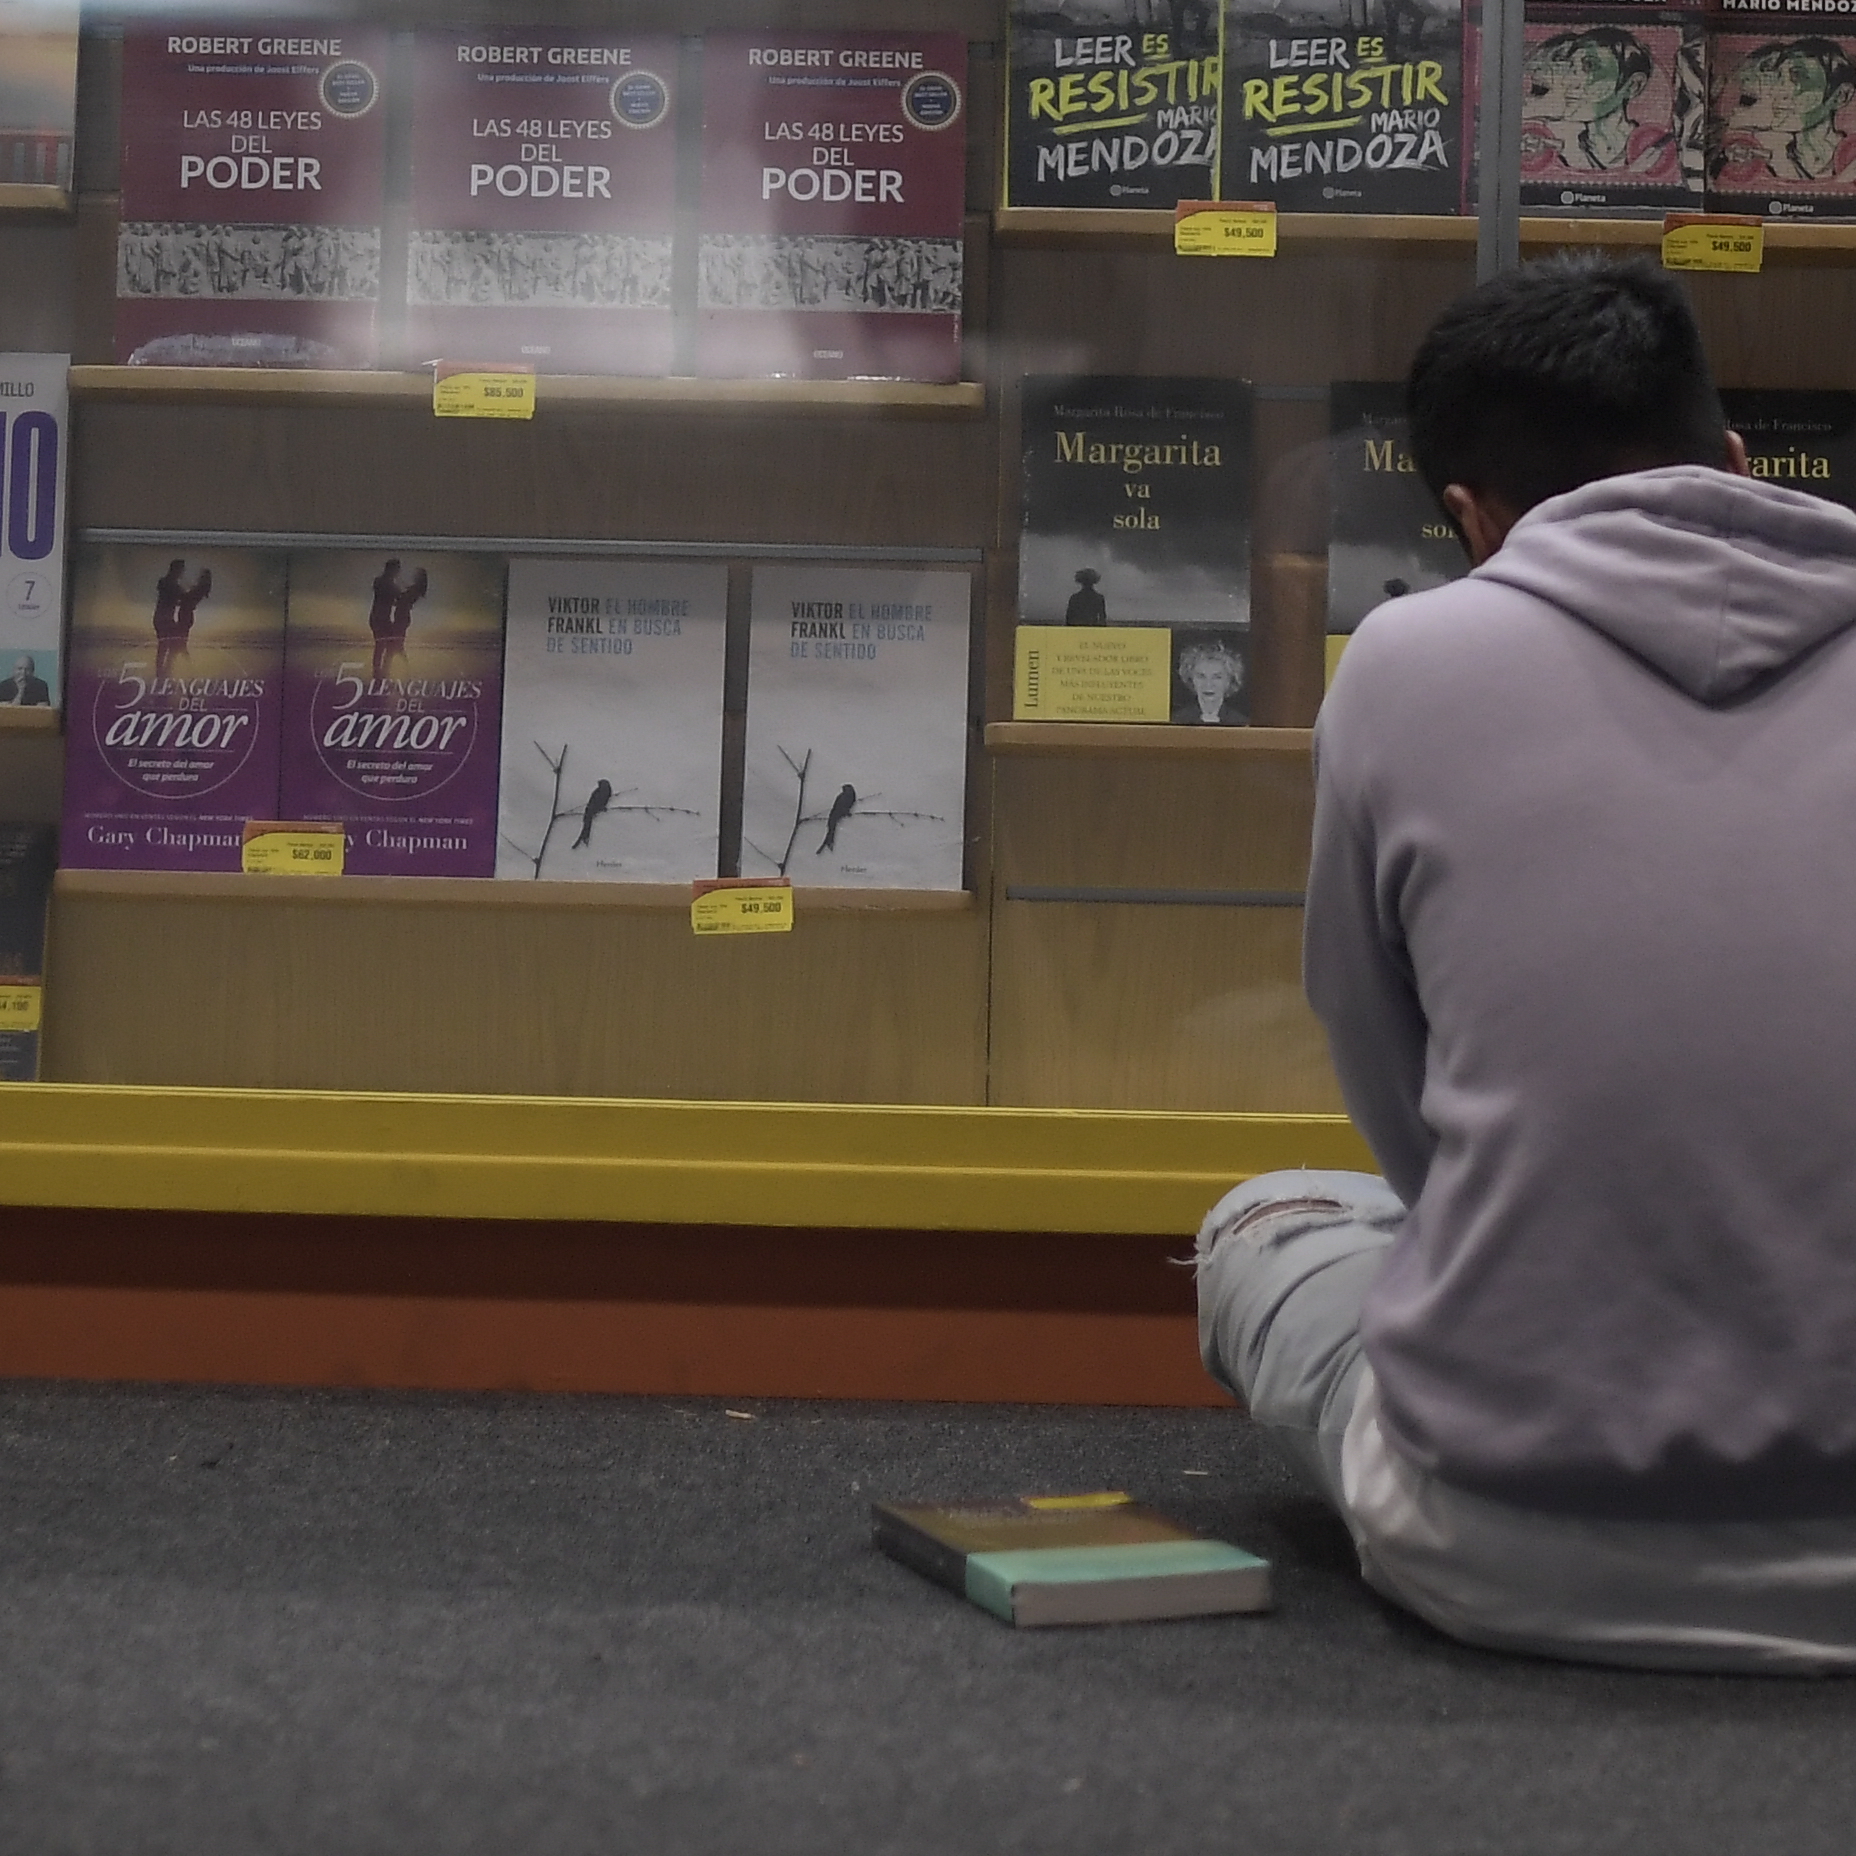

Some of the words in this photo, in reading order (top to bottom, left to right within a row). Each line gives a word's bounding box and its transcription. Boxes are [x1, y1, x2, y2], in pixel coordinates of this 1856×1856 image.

[168, 37, 252, 54] ROBERT
[258, 39, 342, 56] GREENE
[1268, 38, 1350, 69] LEER
[1357, 37, 1384, 57] ES
[749, 49, 833, 66] ROBERT
[839, 51, 923, 68] GREENE
[1243, 61, 1449, 123] RESISTIR
[183, 110, 222, 128] LAS
[226, 111, 252, 128] 48
[258, 112, 322, 130] LEYES
[1370, 108, 1440, 132] MARIO
[231, 135, 272, 153] DEL
[1250, 129, 1449, 184] MENDOZA
[181, 156, 322, 190] PODER
[762, 168, 904, 203] PODER
[1783, 203, 1814, 214] Planeta
[1054, 432, 1222, 473] Margarita
[1124, 482, 1151, 499] va
[1113, 509, 1161, 530] sola
[548, 597, 600, 614] VIKTOR
[606, 598, 622, 614] EL
[628, 599, 690, 617] HOMBRE
[547, 617, 602, 633] FRANKL
[608, 619, 627, 634] EN
[634, 619, 681, 636] BUSCA
[547, 637, 565, 653] DE
[571, 638, 633, 655] SENTIDO
[114, 662, 147, 709] 5
[150, 679, 264, 697] LENGUAJES
[1025, 649, 1039, 709] Lumen
[179, 699, 208, 712] DEL
[105, 709, 248, 750] amor
[87, 826, 136, 849] Gary
[365, 829, 468, 851] Chapman
